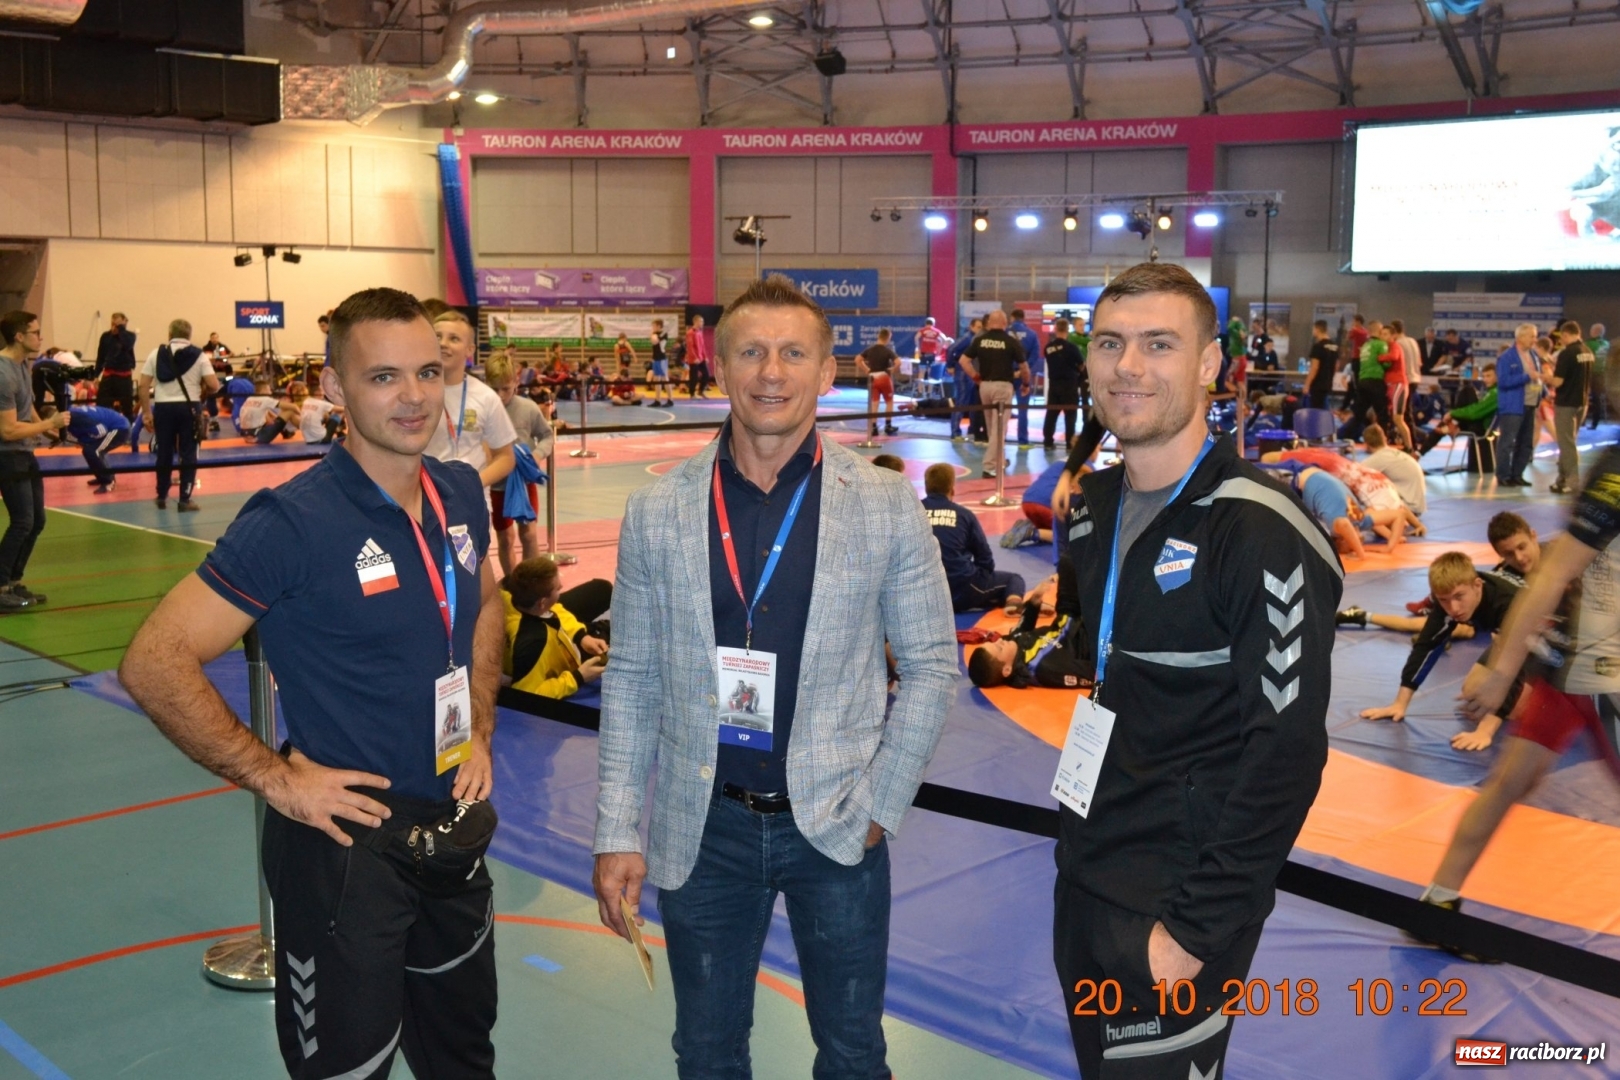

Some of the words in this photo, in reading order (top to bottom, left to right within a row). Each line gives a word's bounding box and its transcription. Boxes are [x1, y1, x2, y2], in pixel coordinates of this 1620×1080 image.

[722, 134, 787, 148] TAURON
[790, 133, 847, 147] ARENA
[851, 129, 923, 146] KRAKÓW
[969, 130, 1035, 144] TAURON
[1038, 127, 1097, 142] ARENA
[1101, 121, 1178, 140] KRAKÓW
[481, 135, 547, 148] TAURON
[550, 135, 606, 148] ARENA
[610, 132, 682, 148] KRAKÓW
[801, 280, 865, 297] Kraków
[241, 307, 270, 317] SPORT
[249, 315, 279, 324] ZONA
[934, 509, 957, 519] UNIA
[355, 553, 392, 570] adidas
[1160, 562, 1185, 574] UNIA
[722, 656, 771, 667] MIĘDZYNARODOWY
[722, 661, 743, 669] TURNIEJ
[738, 733, 750, 741] VIP
[1105, 1015, 1162, 1042] hummel
